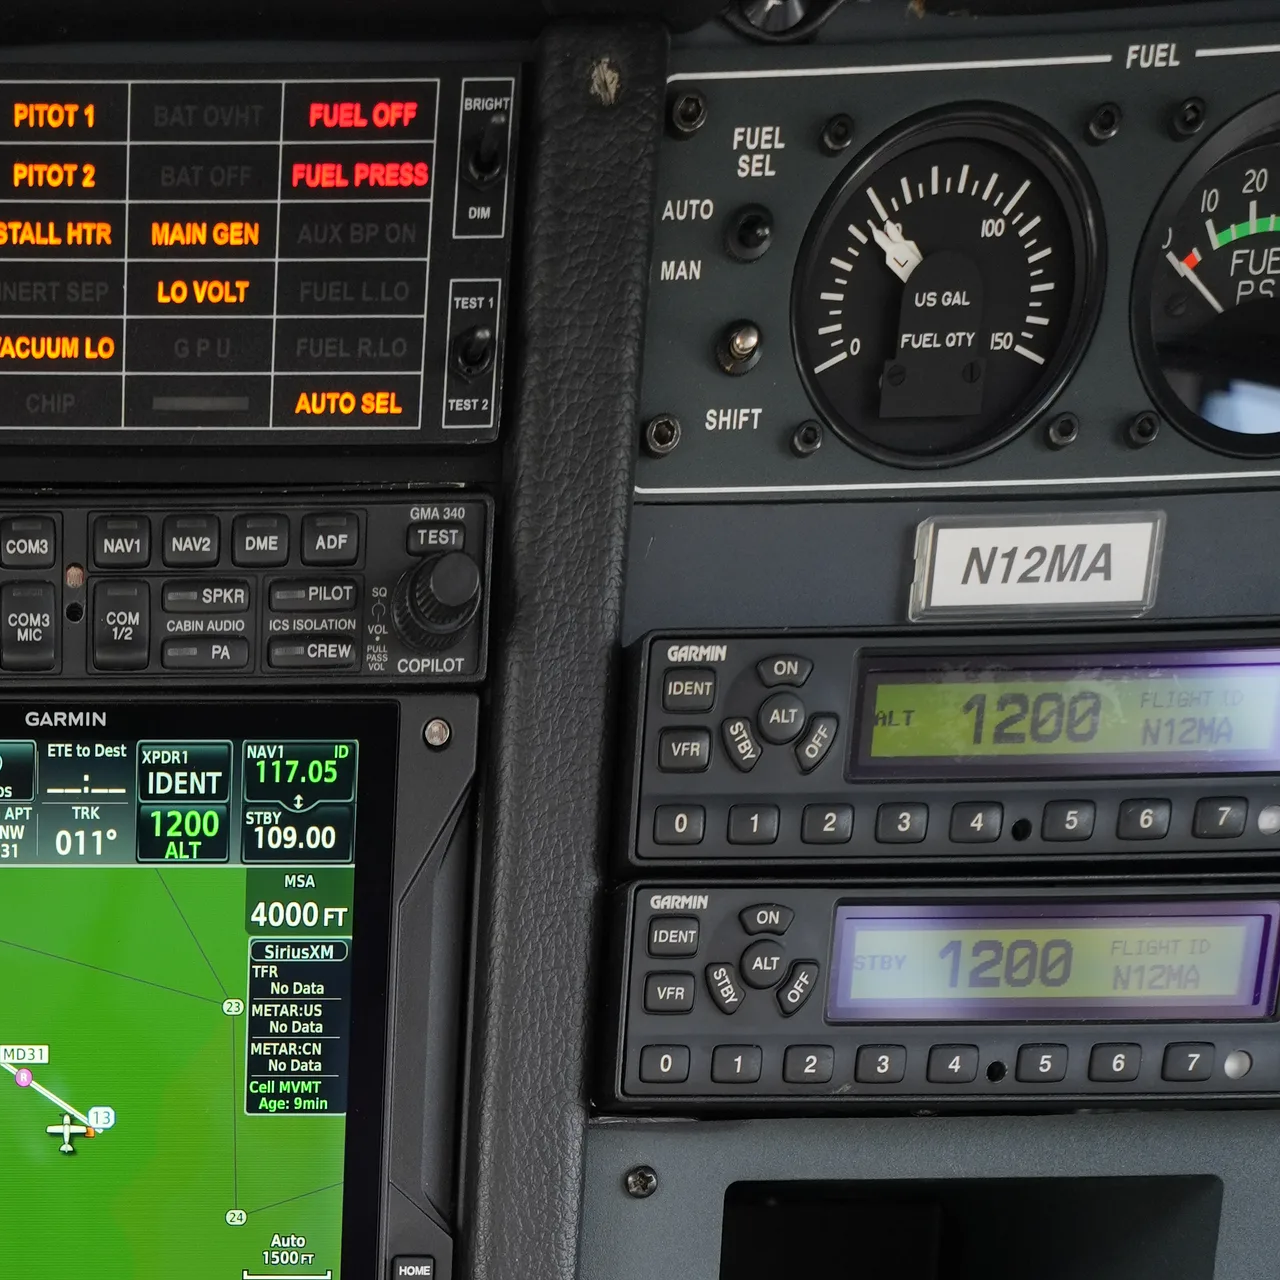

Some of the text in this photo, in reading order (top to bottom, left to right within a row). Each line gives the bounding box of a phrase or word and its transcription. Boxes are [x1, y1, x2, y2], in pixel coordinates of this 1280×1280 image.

[1126, 44, 1180, 69] FUEL
[309, 102, 418, 127] FUEL OFF
[464, 98, 510, 111] BRIGHT
[13, 104, 95, 127] PITOT 1
[733, 127, 785, 150] FUEL
[13, 164, 95, 187] PITOT 2
[292, 163, 428, 187] FUEL PRESS
[738, 155, 775, 177] SEL
[468, 207, 490, 219] DIM
[662, 199, 713, 220] AUTO
[67, 222, 112, 245] HTR
[152, 222, 259, 245] MAIN GEN
[661, 261, 701, 280] MAN
[157, 281, 249, 303] LO VOLT
[915, 291, 970, 307] US GAL
[86, 337, 115, 359] LO
[901, 332, 975, 347] FUEL QTY
[295, 392, 402, 414] AUTO SEL
[706, 408, 762, 430] SHIFT
[6, 540, 48, 554] COM3
[104, 538, 140, 553] NAV1
[172, 537, 210, 552] NAV2
[245, 537, 278, 550] DME
[315, 535, 347, 549] ADF
[961, 543, 1114, 585] N12MA
[167, 620, 245, 632] CABIN AUDIO
[667, 645, 727, 662] GARMIN
[397, 658, 464, 673] COPILOT
[668, 681, 712, 696] IDENT
[25, 712, 106, 726] GARMIN
[962, 693, 1101, 744] 1200
[671, 742, 700, 756] VFR
[256, 760, 337, 783] 117.05
[148, 772, 222, 794] IDENT
[150, 811, 219, 837] 1200
[254, 827, 336, 848] 109.00
[284, 875, 315, 887] MSA
[250, 902, 348, 926] 4000 FT
[264, 945, 334, 960] SiriusXM
[938, 939, 1073, 988] 1200
[3, 1047, 45, 1061] MD31
[399, 1266, 430, 1276] HOME
